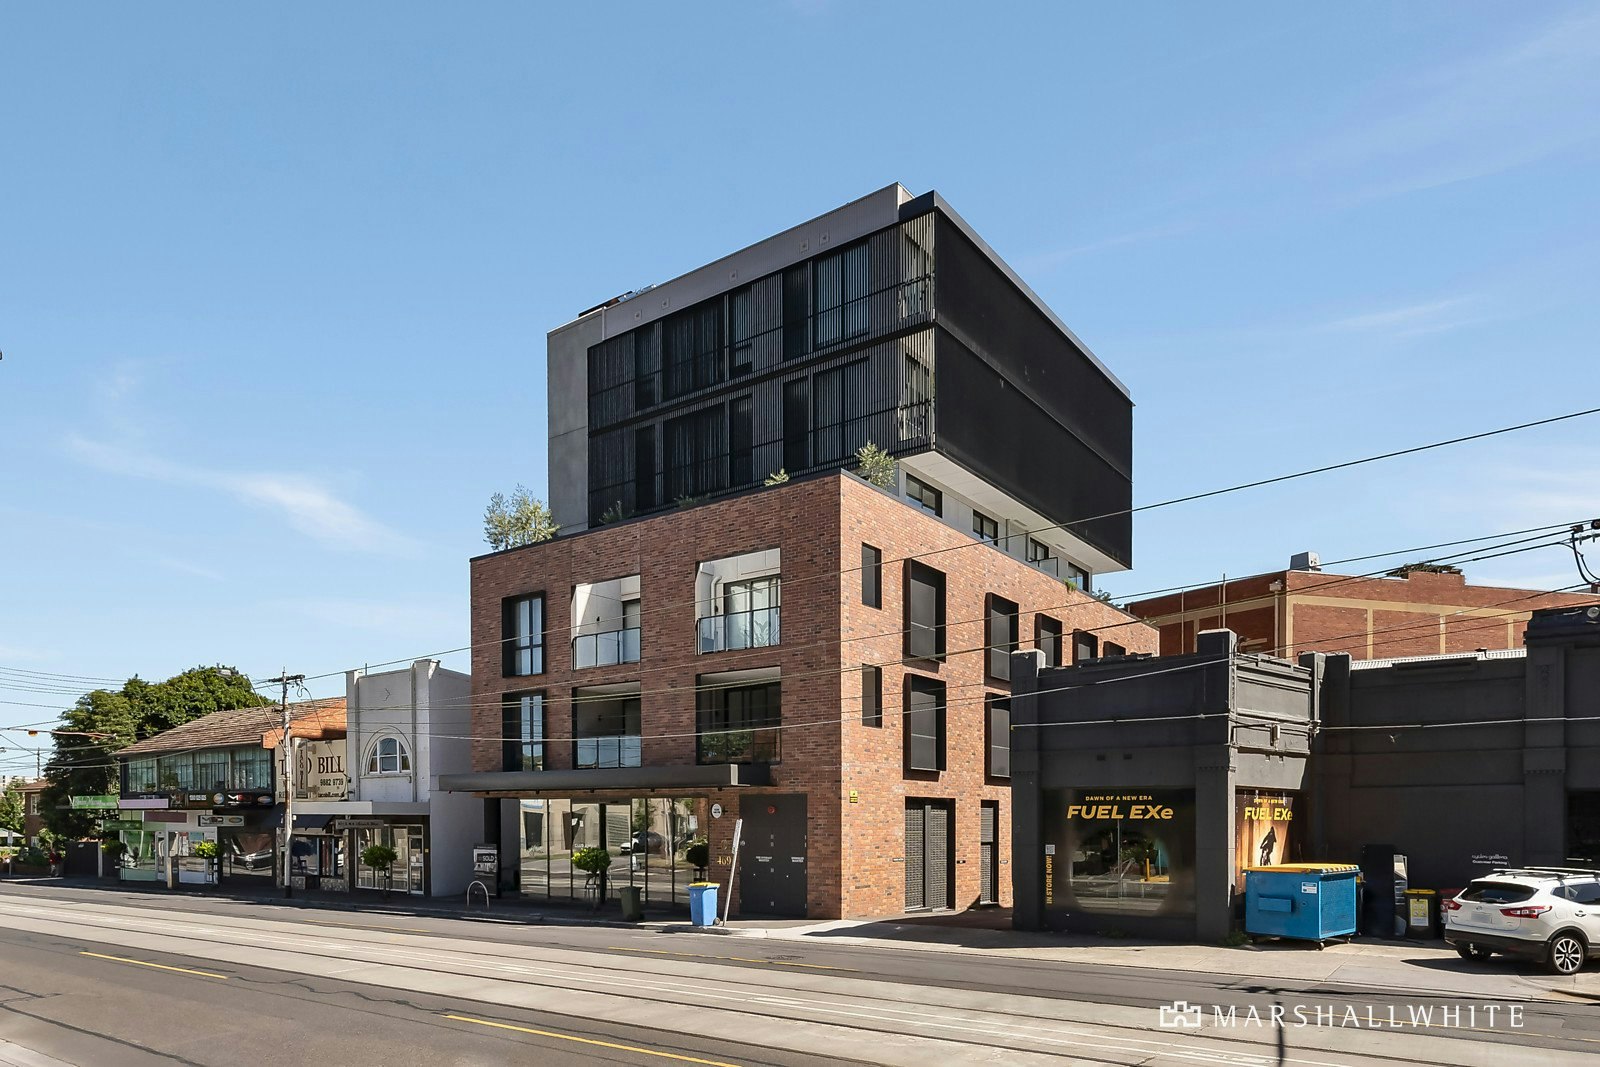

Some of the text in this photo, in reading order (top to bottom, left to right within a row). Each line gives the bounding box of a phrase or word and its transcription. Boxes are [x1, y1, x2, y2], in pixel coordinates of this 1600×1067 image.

[317, 755, 345, 774] BILL
[1066, 805, 1174, 820] FUEL EXe
[1244, 806, 1293, 821] FUEL EXe
[717, 855, 732, 865] 469
[1045, 874, 1053, 896] STORE
[1046, 896, 1053, 904] IN
